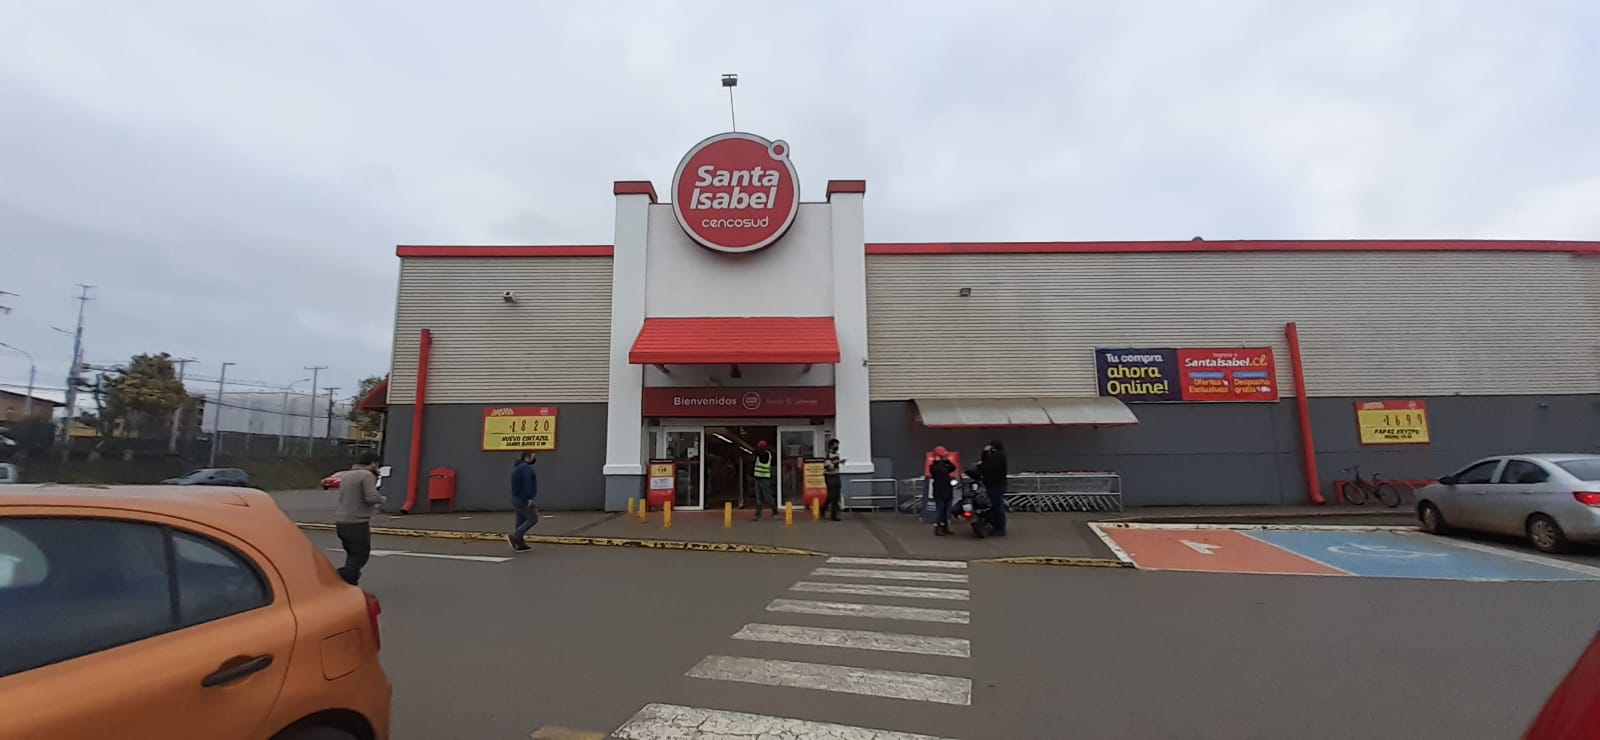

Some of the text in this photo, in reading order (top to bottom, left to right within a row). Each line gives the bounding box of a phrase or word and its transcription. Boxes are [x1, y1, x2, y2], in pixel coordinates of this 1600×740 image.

[695, 165, 780, 187] Santa
[690, 187, 777, 209] Isabel
[702, 216, 769, 228] cencosud
[1105, 353, 1163, 364] Tu compra
[1107, 364, 1162, 378] ahora
[1106, 379, 1169, 395] Online!
[673, 396, 737, 406] Bienvenidos
